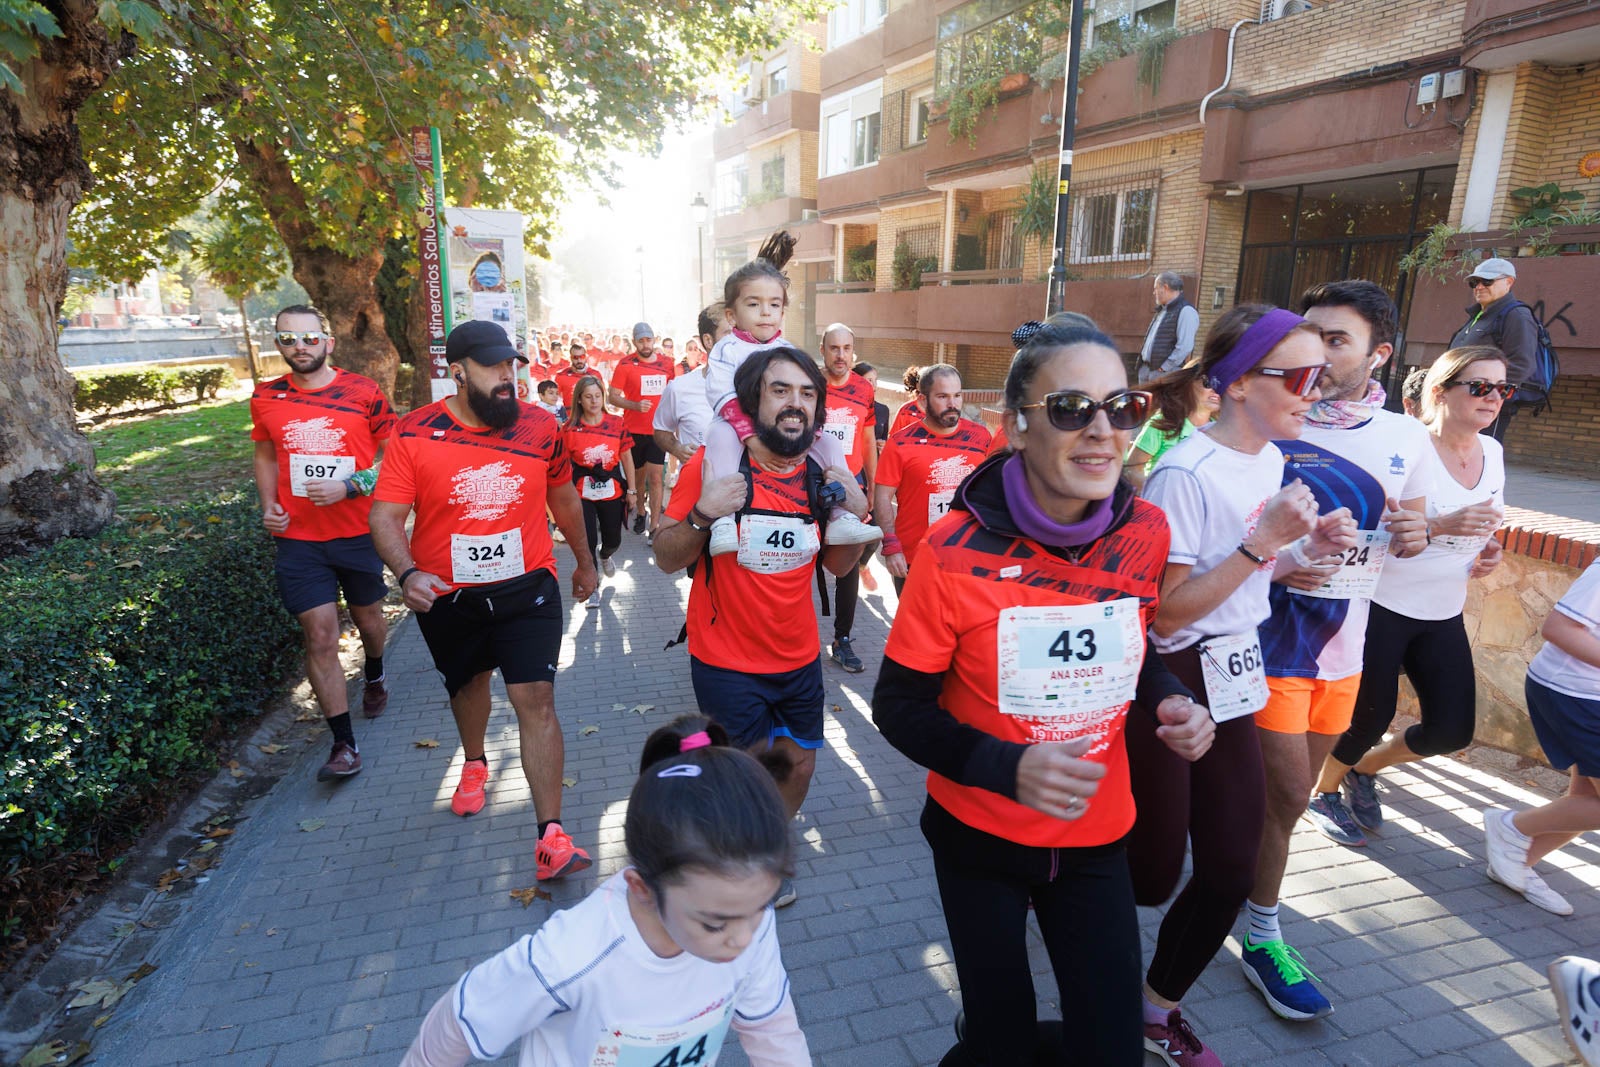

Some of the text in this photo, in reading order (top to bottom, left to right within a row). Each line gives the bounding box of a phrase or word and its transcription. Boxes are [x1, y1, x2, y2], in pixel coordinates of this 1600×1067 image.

[1345, 219, 1355, 234] 2
[646, 379, 662, 387] 1511
[285, 430, 341, 441] carrera
[304, 464, 337, 478] 697
[455, 478, 518, 494] carrera
[766, 530, 795, 549] 46
[467, 543, 506, 562] 324
[1048, 628, 1097, 663] 43
[1228, 644, 1262, 677] 662
[1051, 666, 1104, 680] ANA SOLER
[653, 1033, 708, 1067] 44
